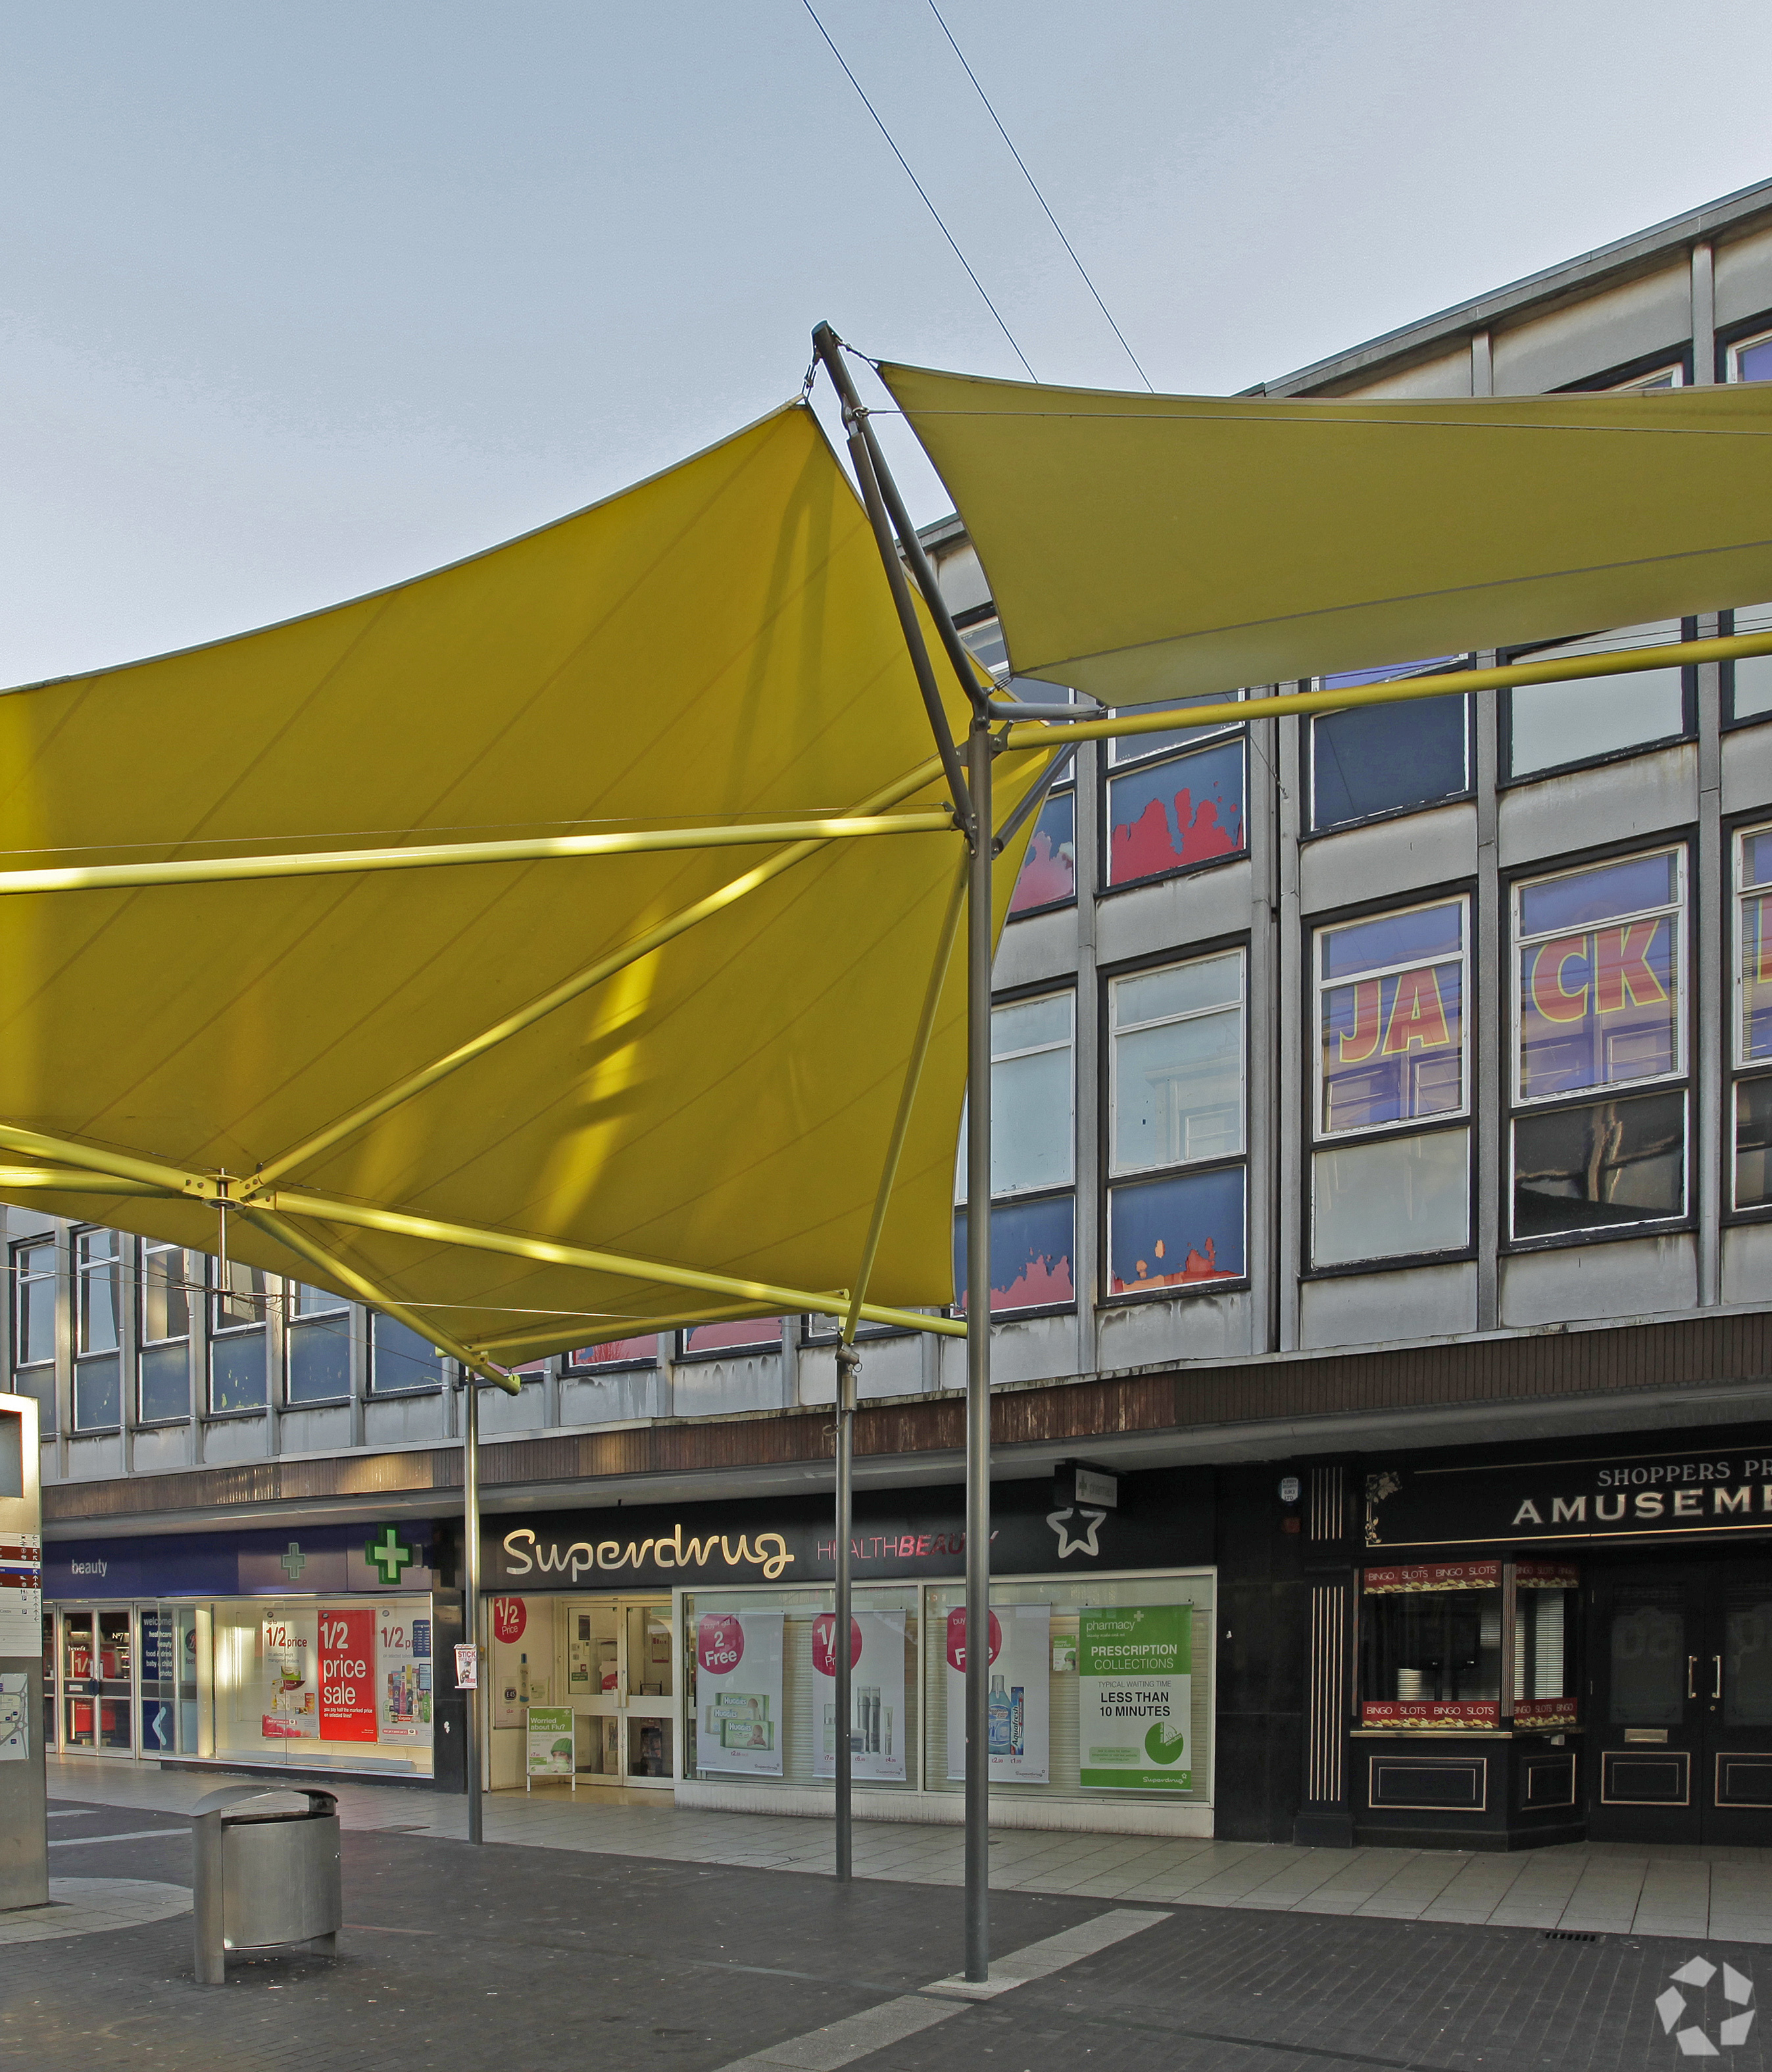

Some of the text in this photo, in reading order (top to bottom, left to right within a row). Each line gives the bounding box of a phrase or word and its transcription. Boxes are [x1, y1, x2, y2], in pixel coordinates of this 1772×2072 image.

[1597, 1461, 1731, 1487] SHOPPERS
[502, 1523, 795, 1583] Superdrug
[72, 1558, 107, 1577] beauty
[1368, 1566, 1496, 1581] BINGO SLOTS BINGO SLOTS
[496, 1597, 520, 1625] 1/2
[143, 1616, 172, 1626] welcome
[1086, 1621, 1135, 1633] pharmacy
[320, 1621, 349, 1649] 1/2
[501, 1625, 518, 1635] Price
[266, 1627, 286, 1646] 1/2
[381, 1627, 404, 1648] 1/2
[714, 1631, 725, 1648] 2
[287, 1637, 307, 1649] price
[1091, 1644, 1177, 1656] PRESCRIPTION
[704, 1650, 737, 1667] Free
[1094, 1658, 1174, 1670] COLLECTIONS
[323, 1654, 366, 1683] price
[324, 1681, 356, 1705] sale
[1100, 1691, 1169, 1703] LESS THAN
[1100, 1706, 1171, 1717] 10 MINUTES
[1366, 1706, 1494, 1715] BINGO SLOTS BINGO SLOTS
[1514, 1703, 1573, 1714] BINGO SLOTS BINGO
[1165, 1734, 1182, 1746] minutes
[1166, 1731, 1173, 1740] 10
[1143, 1776, 1184, 1785] Superdrug
